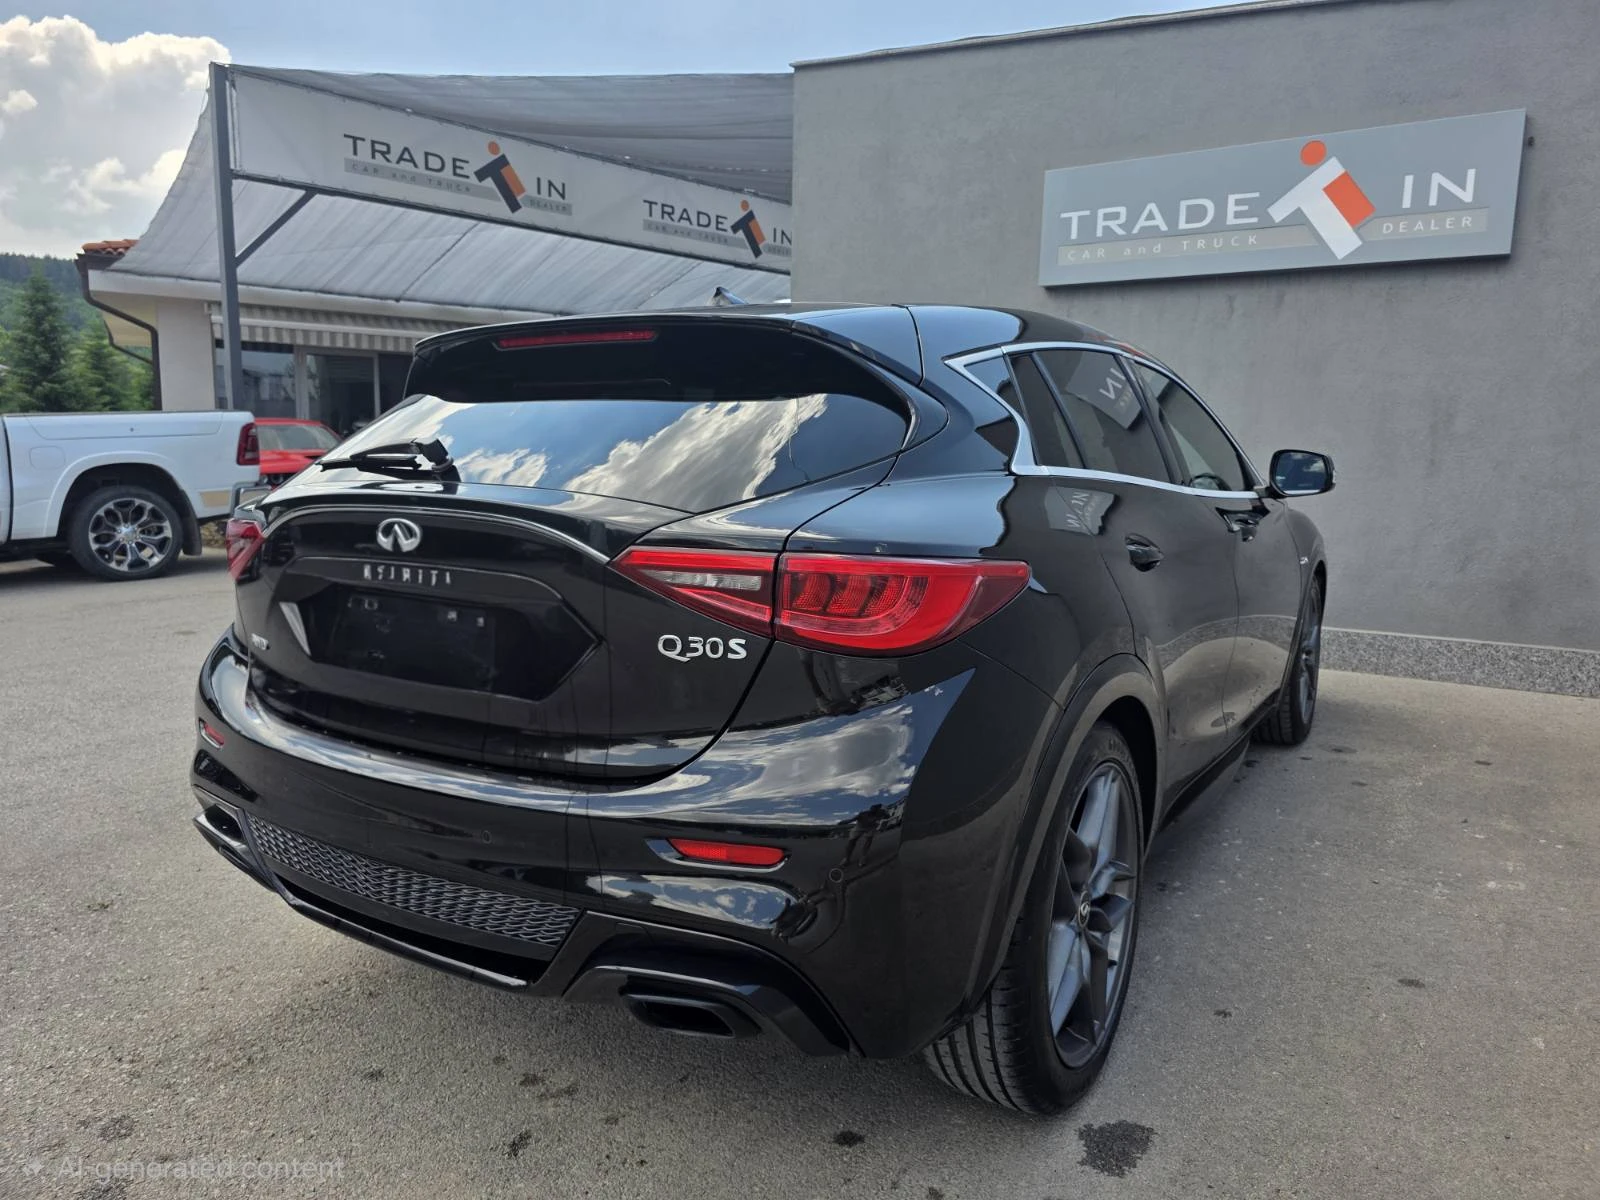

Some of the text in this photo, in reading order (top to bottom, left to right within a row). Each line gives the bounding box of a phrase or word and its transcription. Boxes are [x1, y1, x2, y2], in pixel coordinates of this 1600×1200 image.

[343, 133, 470, 180] TRADE
[536, 175, 566, 201] IN
[643, 199, 728, 232] TRADE
[1060, 191, 1260, 240] TRADE
[1402, 168, 1477, 209] IN
[1067, 216, 1473, 262] CAR and TRUCK DEALER
[657, 634, 748, 662] Q30S
